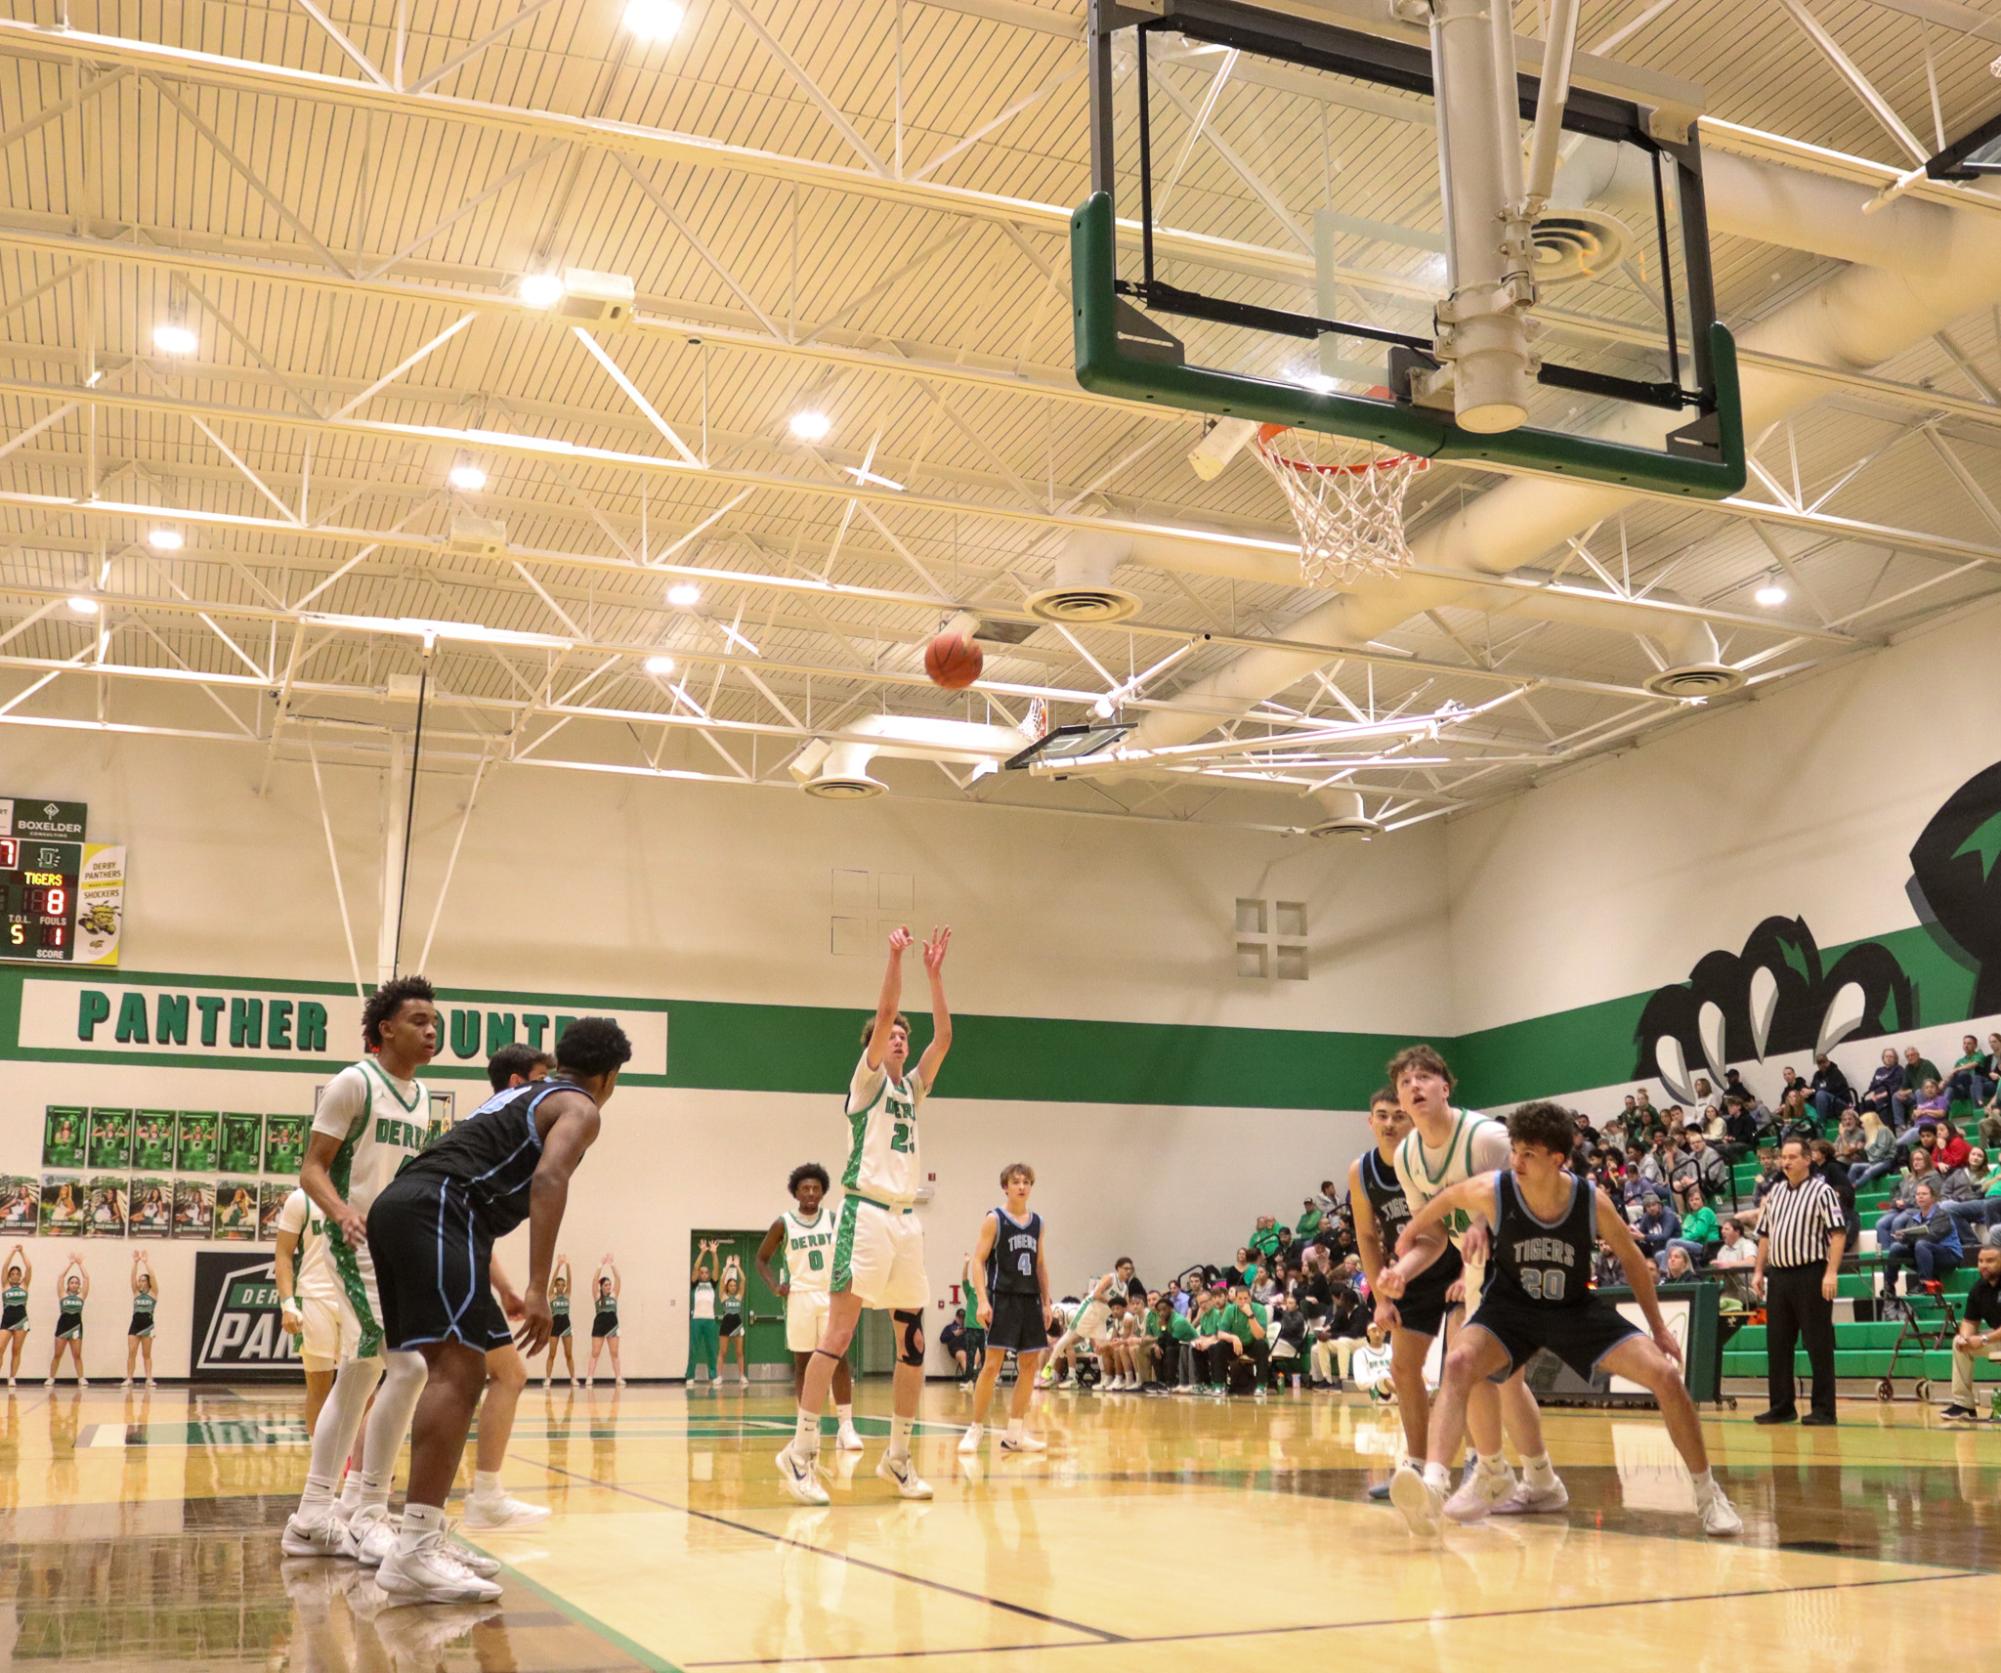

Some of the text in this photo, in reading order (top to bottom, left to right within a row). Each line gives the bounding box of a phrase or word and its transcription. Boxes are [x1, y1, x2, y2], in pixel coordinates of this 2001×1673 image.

[17, 820, 82, 833] BOXELDER
[84, 870, 121, 880] PANTHERS
[93, 862, 116, 871] DERBY
[24, 871, 63, 887] TIGERS
[47, 889, 65, 915] 8
[83, 889, 119, 899] SHOCKERS
[40, 916, 67, 926] FOULS
[36, 949, 64, 960] SCORE
[78, 990, 327, 1052] PANTHER
[791, 1233, 832, 1251] DERBY
[808, 1250, 824, 1271] 0
[1513, 1238, 1575, 1268] TIGERS
[1018, 1253, 1031, 1276] 4
[1520, 1267, 1566, 1301] 20
[241, 1288, 280, 1305] DER
